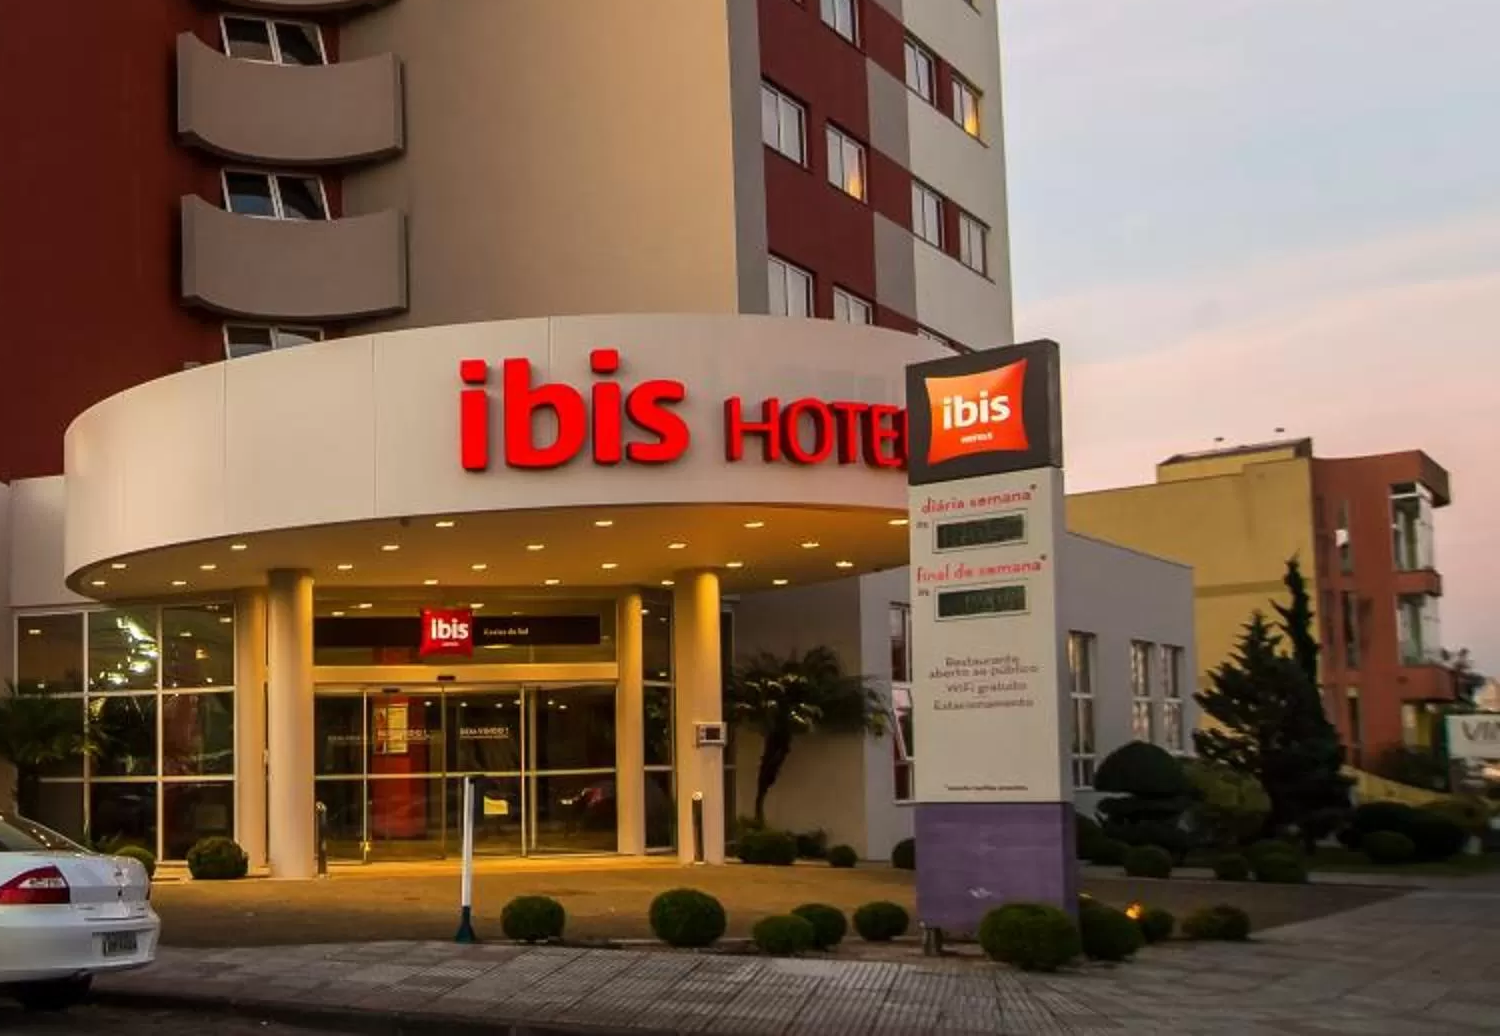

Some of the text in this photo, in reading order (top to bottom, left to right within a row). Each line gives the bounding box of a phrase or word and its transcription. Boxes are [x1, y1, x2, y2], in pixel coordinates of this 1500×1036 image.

[460, 349, 908, 471] ibis HOTE
[943, 390, 1011, 432] ibis
